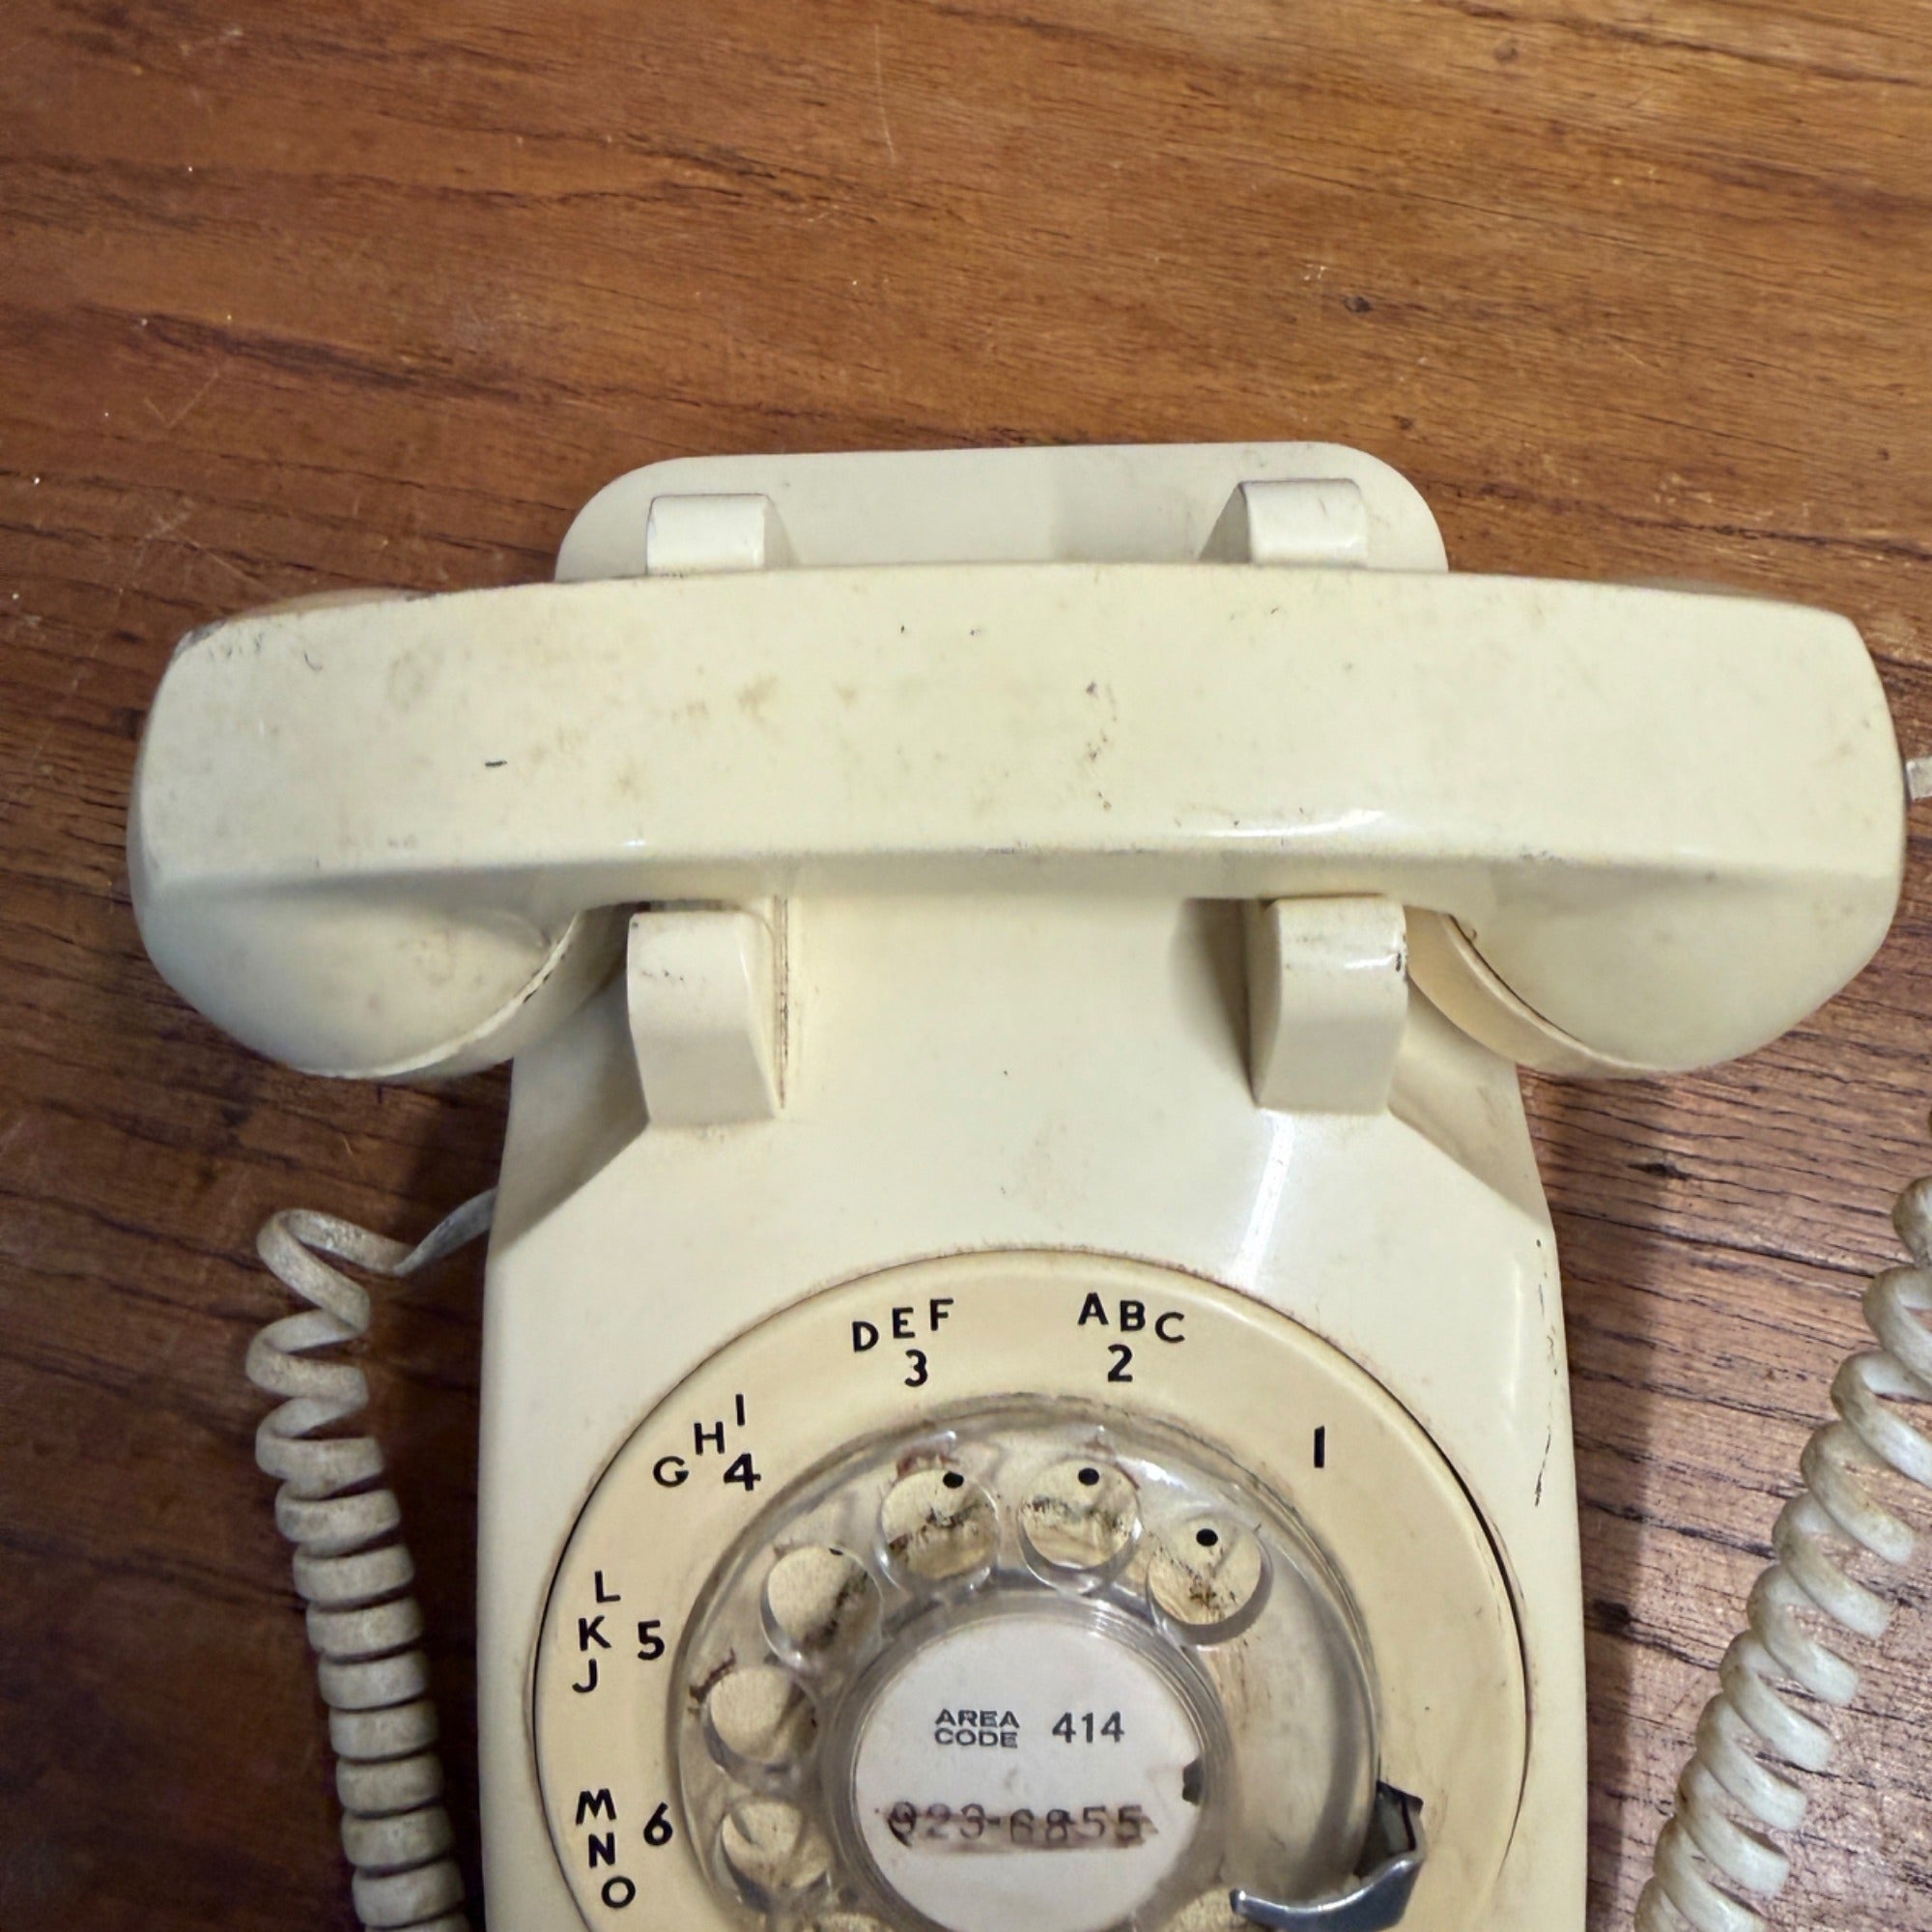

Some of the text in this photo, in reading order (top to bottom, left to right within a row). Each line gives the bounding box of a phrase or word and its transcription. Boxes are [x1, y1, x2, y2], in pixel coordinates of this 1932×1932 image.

[904, 1350, 928, 1387] 3
[1108, 1345, 1133, 1381] 2
[724, 1453, 761, 1492] 4
[638, 1620, 666, 1661] 5
[935, 1709, 1020, 1728] AREA
[1052, 1711, 1124, 1744] 414
[934, 1727, 1018, 1748] CODE
[643, 1803, 674, 1847] 6
